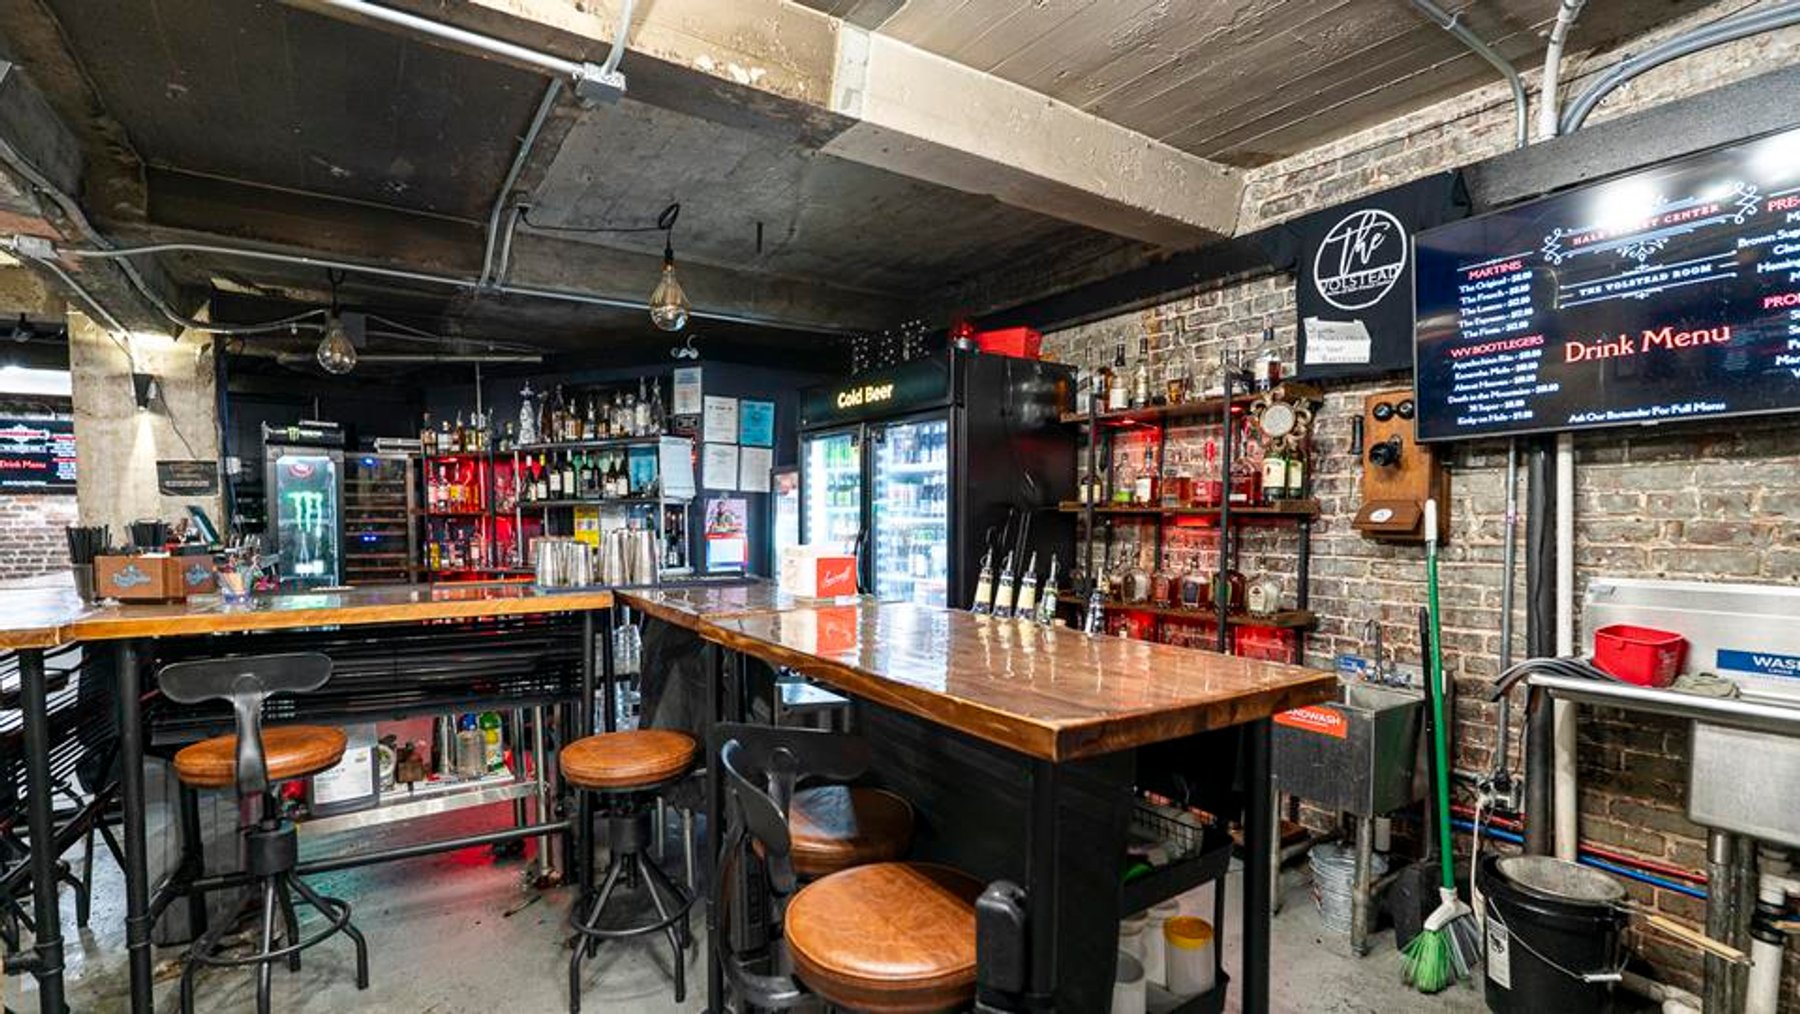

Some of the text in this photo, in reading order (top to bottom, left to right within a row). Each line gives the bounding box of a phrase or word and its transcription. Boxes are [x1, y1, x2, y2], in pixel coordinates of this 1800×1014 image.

[1664, 203, 1719, 223] CENTER
[1326, 211, 1391, 276] The
[1672, 264, 1713, 279] ROOM
[1564, 325, 1731, 364] Drink Menu
[837, 384, 894, 409] Cold Beer
